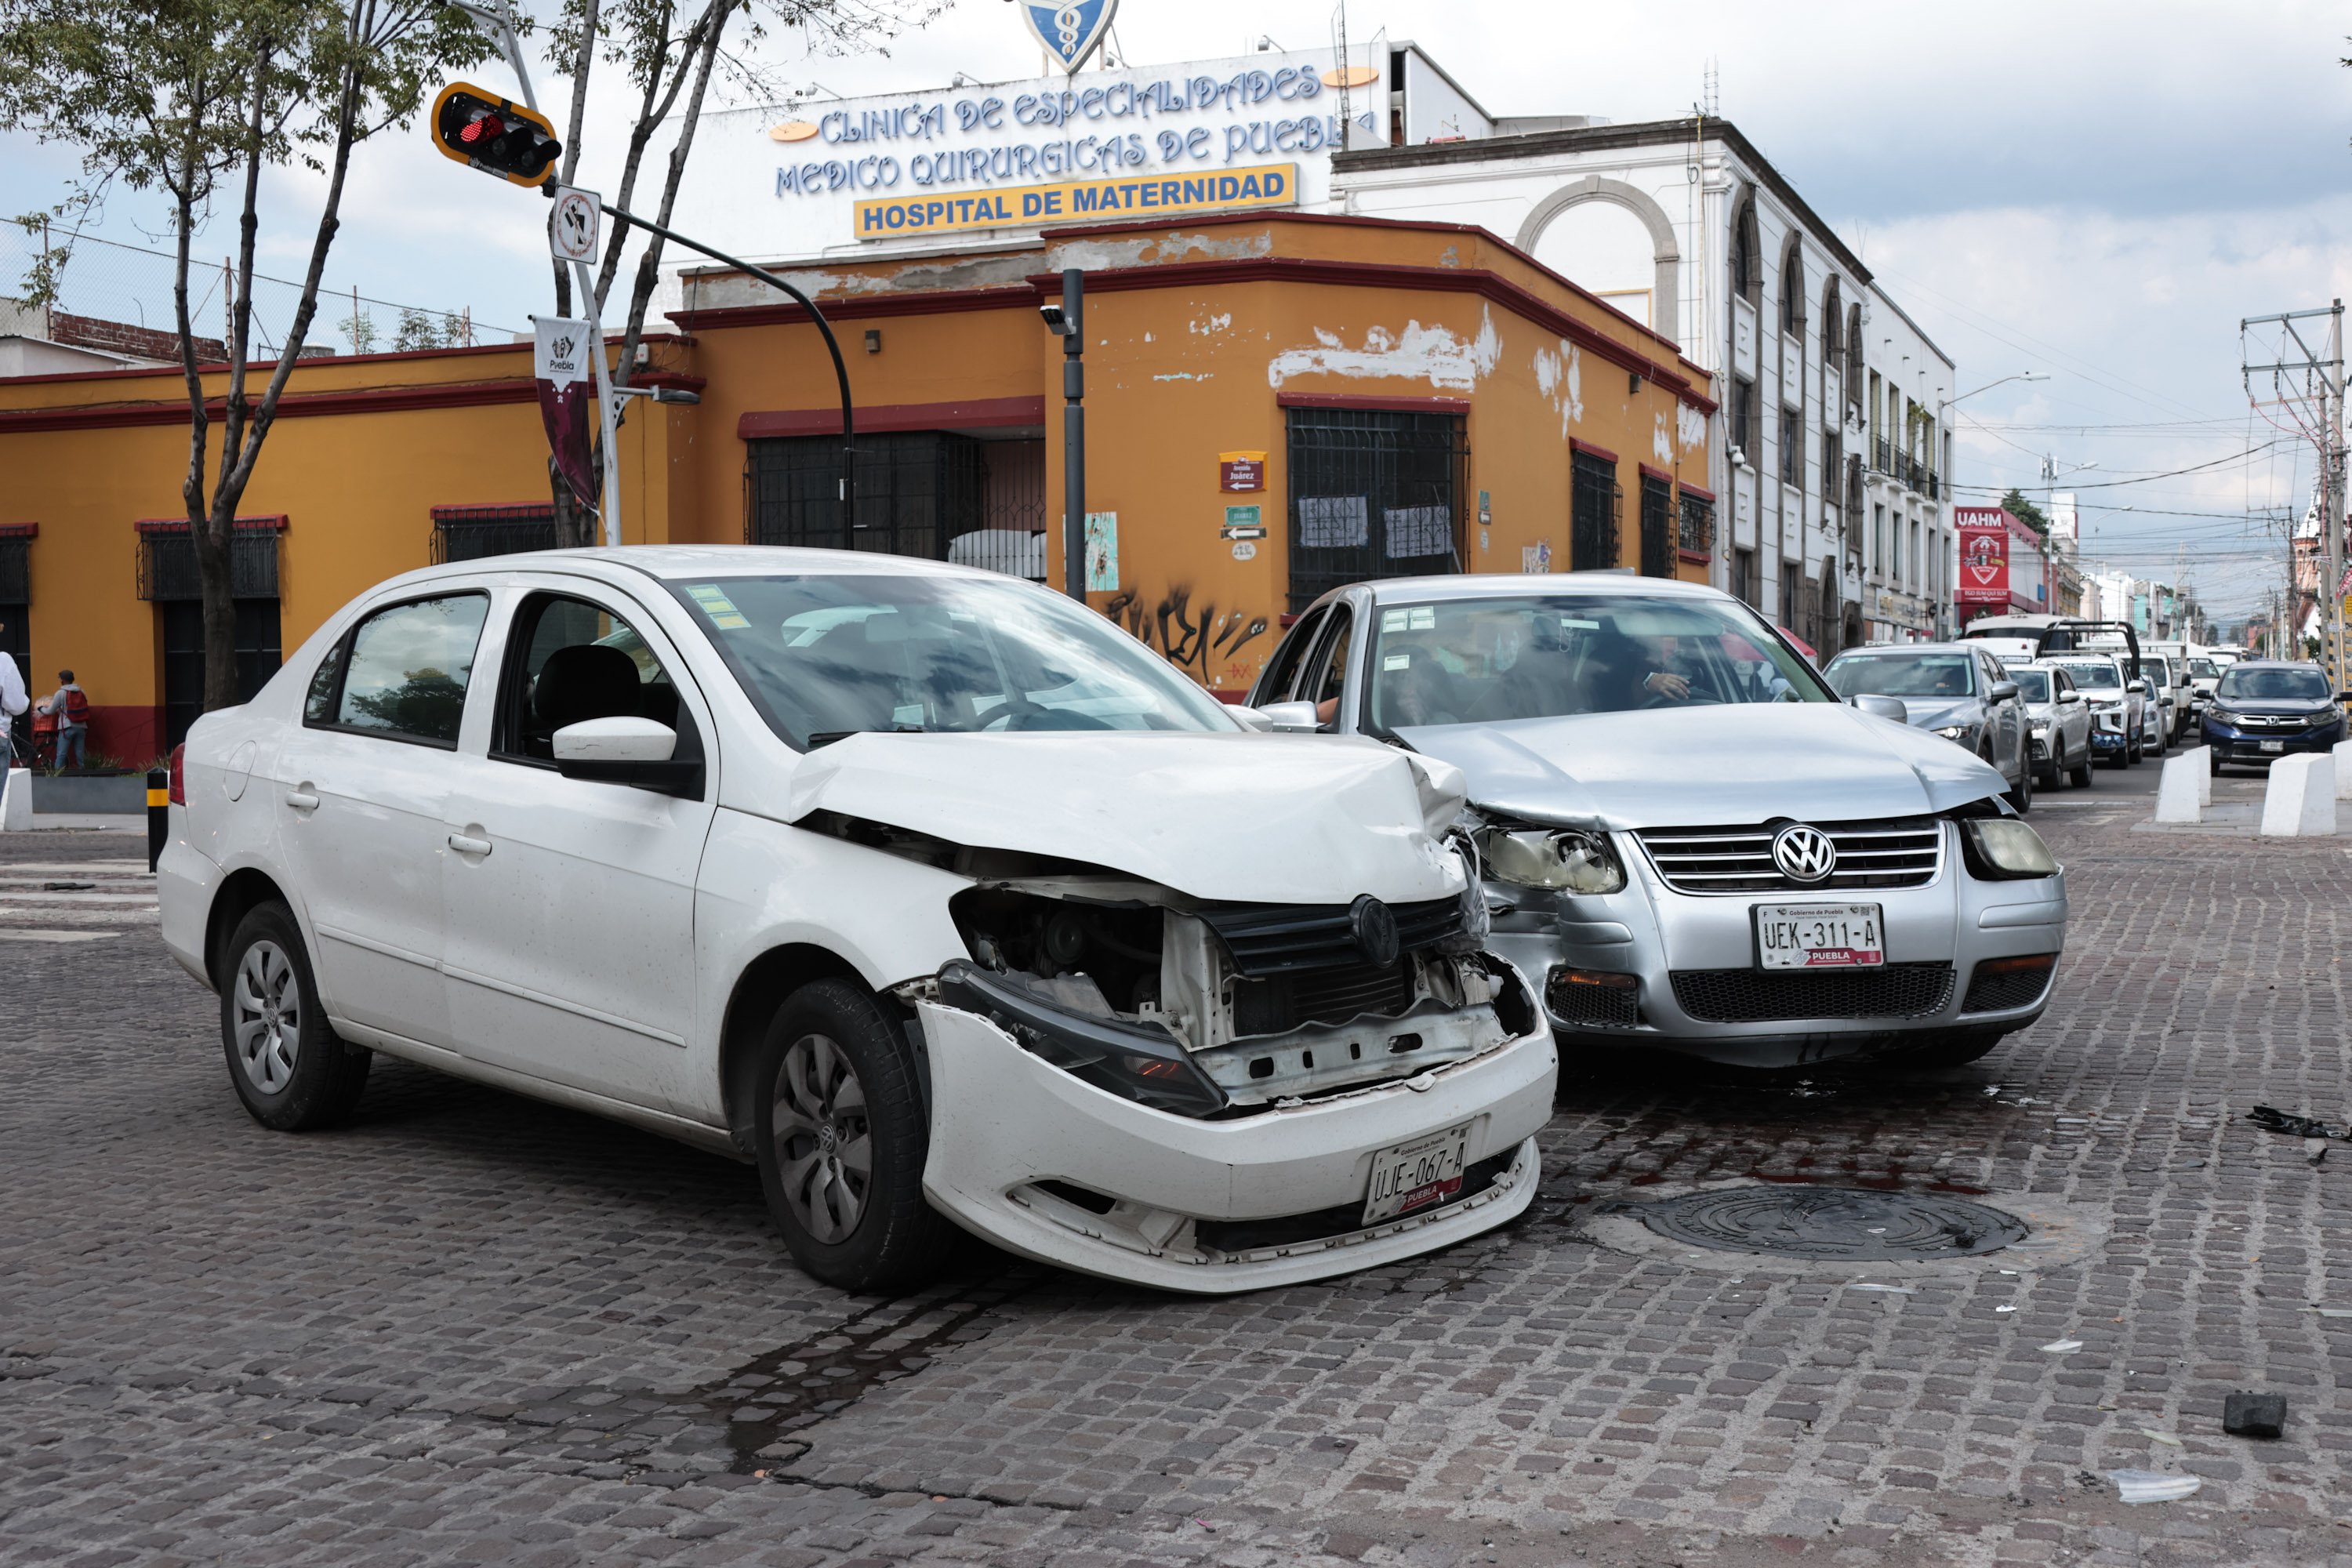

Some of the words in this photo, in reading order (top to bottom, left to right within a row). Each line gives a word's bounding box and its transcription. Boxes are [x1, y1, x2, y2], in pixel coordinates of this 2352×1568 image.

[819, 103, 943, 143] CLINICA
[954, 97, 1004, 130] DE
[1013, 64, 1321, 128] ESPECIALIDADES
[775, 154, 900, 196] MEDICO
[910, 133, 1146, 186] QUIRURGICAS
[1156, 126, 1210, 162] DE
[863, 196, 1012, 231] HOSPITAL
[1022, 191, 1062, 217] DE
[1073, 172, 1284, 212] MATERNIDAD
[550, 360, 574, 370] Puebla
[1229, 470, 1254, 480] Juárez
[1957, 512, 2002, 527] UAHM
[1764, 920, 1876, 949] UEK-311-A
[1812, 952, 1850, 960] PUEBLA
[1401, 1145, 1423, 1156] Gobierno
[1374, 1142, 1465, 1202] UJE-067-A
[1407, 1185, 1437, 1203] PUEBLA
